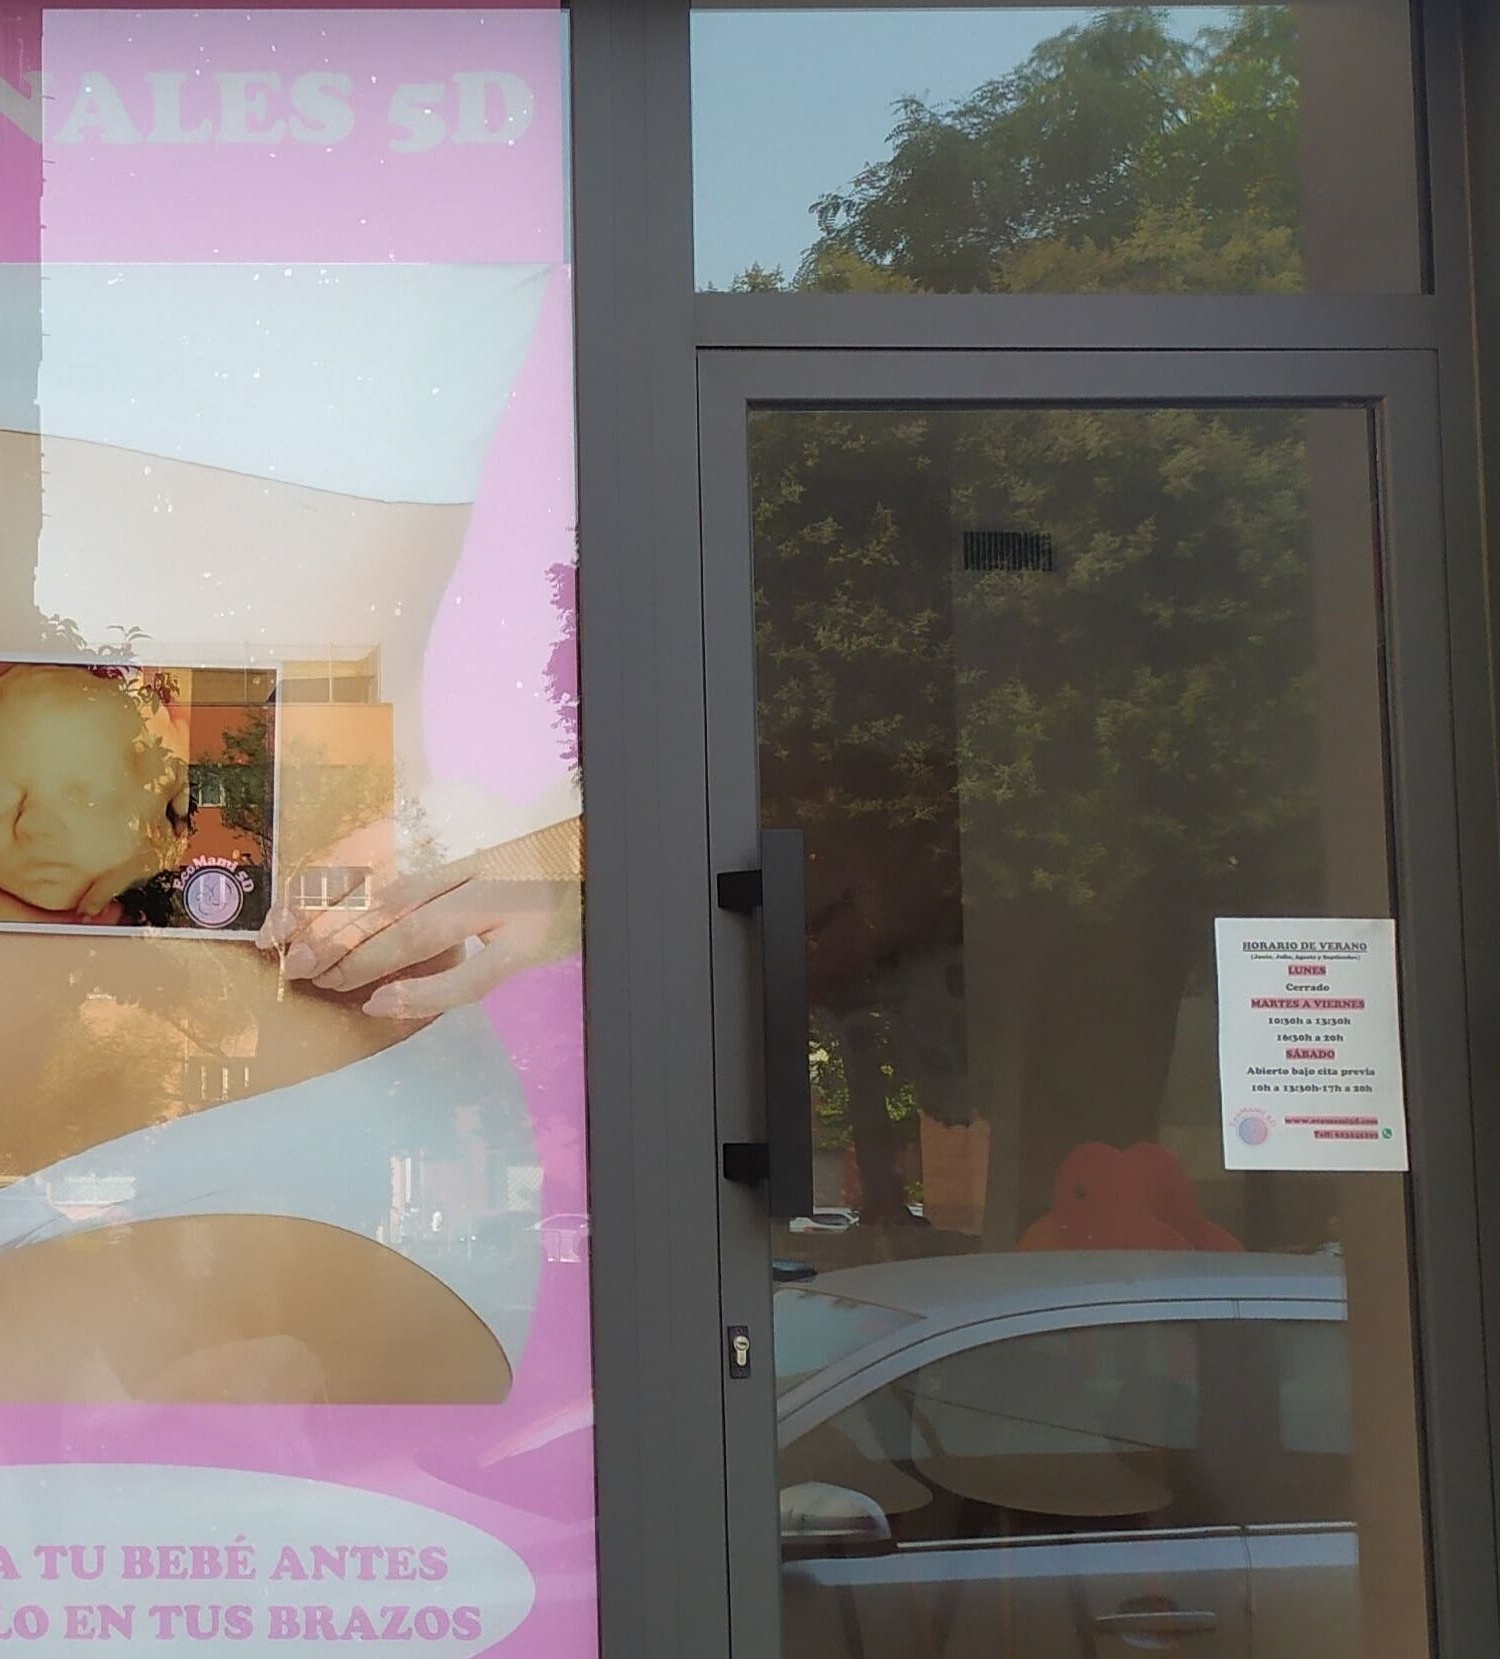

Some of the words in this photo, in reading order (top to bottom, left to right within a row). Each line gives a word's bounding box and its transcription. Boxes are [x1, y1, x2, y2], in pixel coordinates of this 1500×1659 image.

[386, 70, 535, 153] 5D
[172, 855, 239, 891] EcoMami
[235, 870, 255, 893] 5D
[1242, 941, 1299, 951] HORARIO
[1300, 942, 1317, 951] DE
[1319, 942, 1368, 951] VERANO
[1288, 965, 1327, 976] LUNES
[1286, 983, 1330, 992] Cerrado
[1251, 999, 1300, 1009] MARTES
[1301, 1000, 1312, 1009] A
[1313, 1000, 1365, 1009] VIERNES
[1268, 1017, 1304, 1026] 10:30h
[1315, 1017, 1351, 1026] 13:30h
[1277, 1034, 1313, 1043] 16:30h
[1324, 1034, 1344, 1042] 20h
[1286, 1048, 1335, 1060] SÁBADO
[1247, 1067, 1289, 1076] Abierto
[1291, 1067, 1316, 1078] bajo
[1317, 1067, 1338, 1076] cita
[1340, 1068, 1375, 1077] previa
[1251, 1084, 1271, 1092] 10h
[1352, 1085, 1373, 1093] 20h
[35, 1545, 106, 1581] TU
[120, 1535, 257, 1581] BEBÉ
[269, 1545, 449, 1581] ANTES
[63, 1604, 135, 1641] EN
[149, 1604, 254, 1641] TUS
[266, 1604, 483, 1642] BRAZOS
